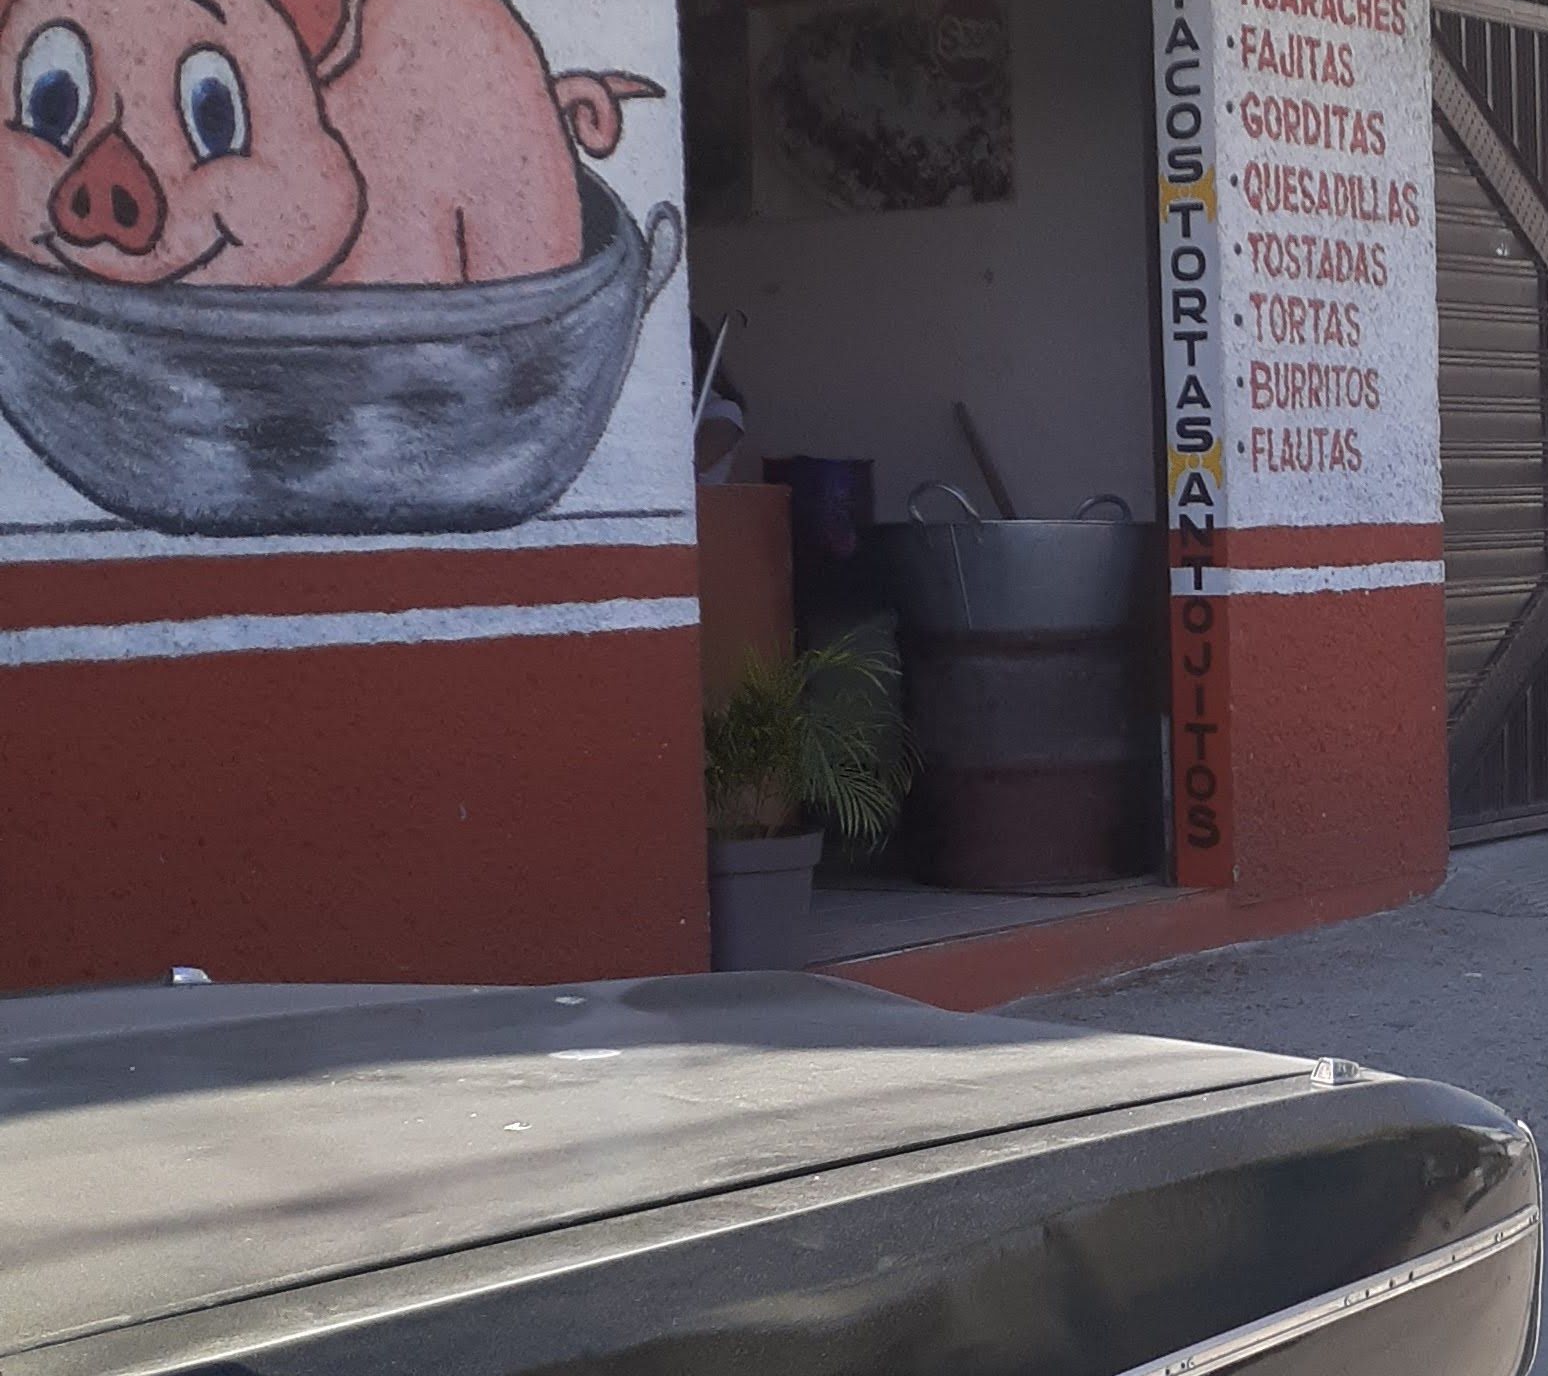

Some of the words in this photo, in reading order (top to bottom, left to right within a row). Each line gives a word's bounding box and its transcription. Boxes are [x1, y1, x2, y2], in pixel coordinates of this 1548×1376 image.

[1239, 24, 1356, 89] FAJITAS
[1240, 91, 1388, 157] GORDITAS
[1243, 161, 1421, 227] QUESADILLAS
[1247, 231, 1389, 288] TOSTADAS
[1167, 203, 1214, 453] TORTAS
[1249, 293, 1361, 348] TORTAS
[1250, 360, 1381, 412] BURRITOS
[1250, 426, 1363, 474] FLAUTAS
[1175, 471, 1220, 850] ANTOJITOS
